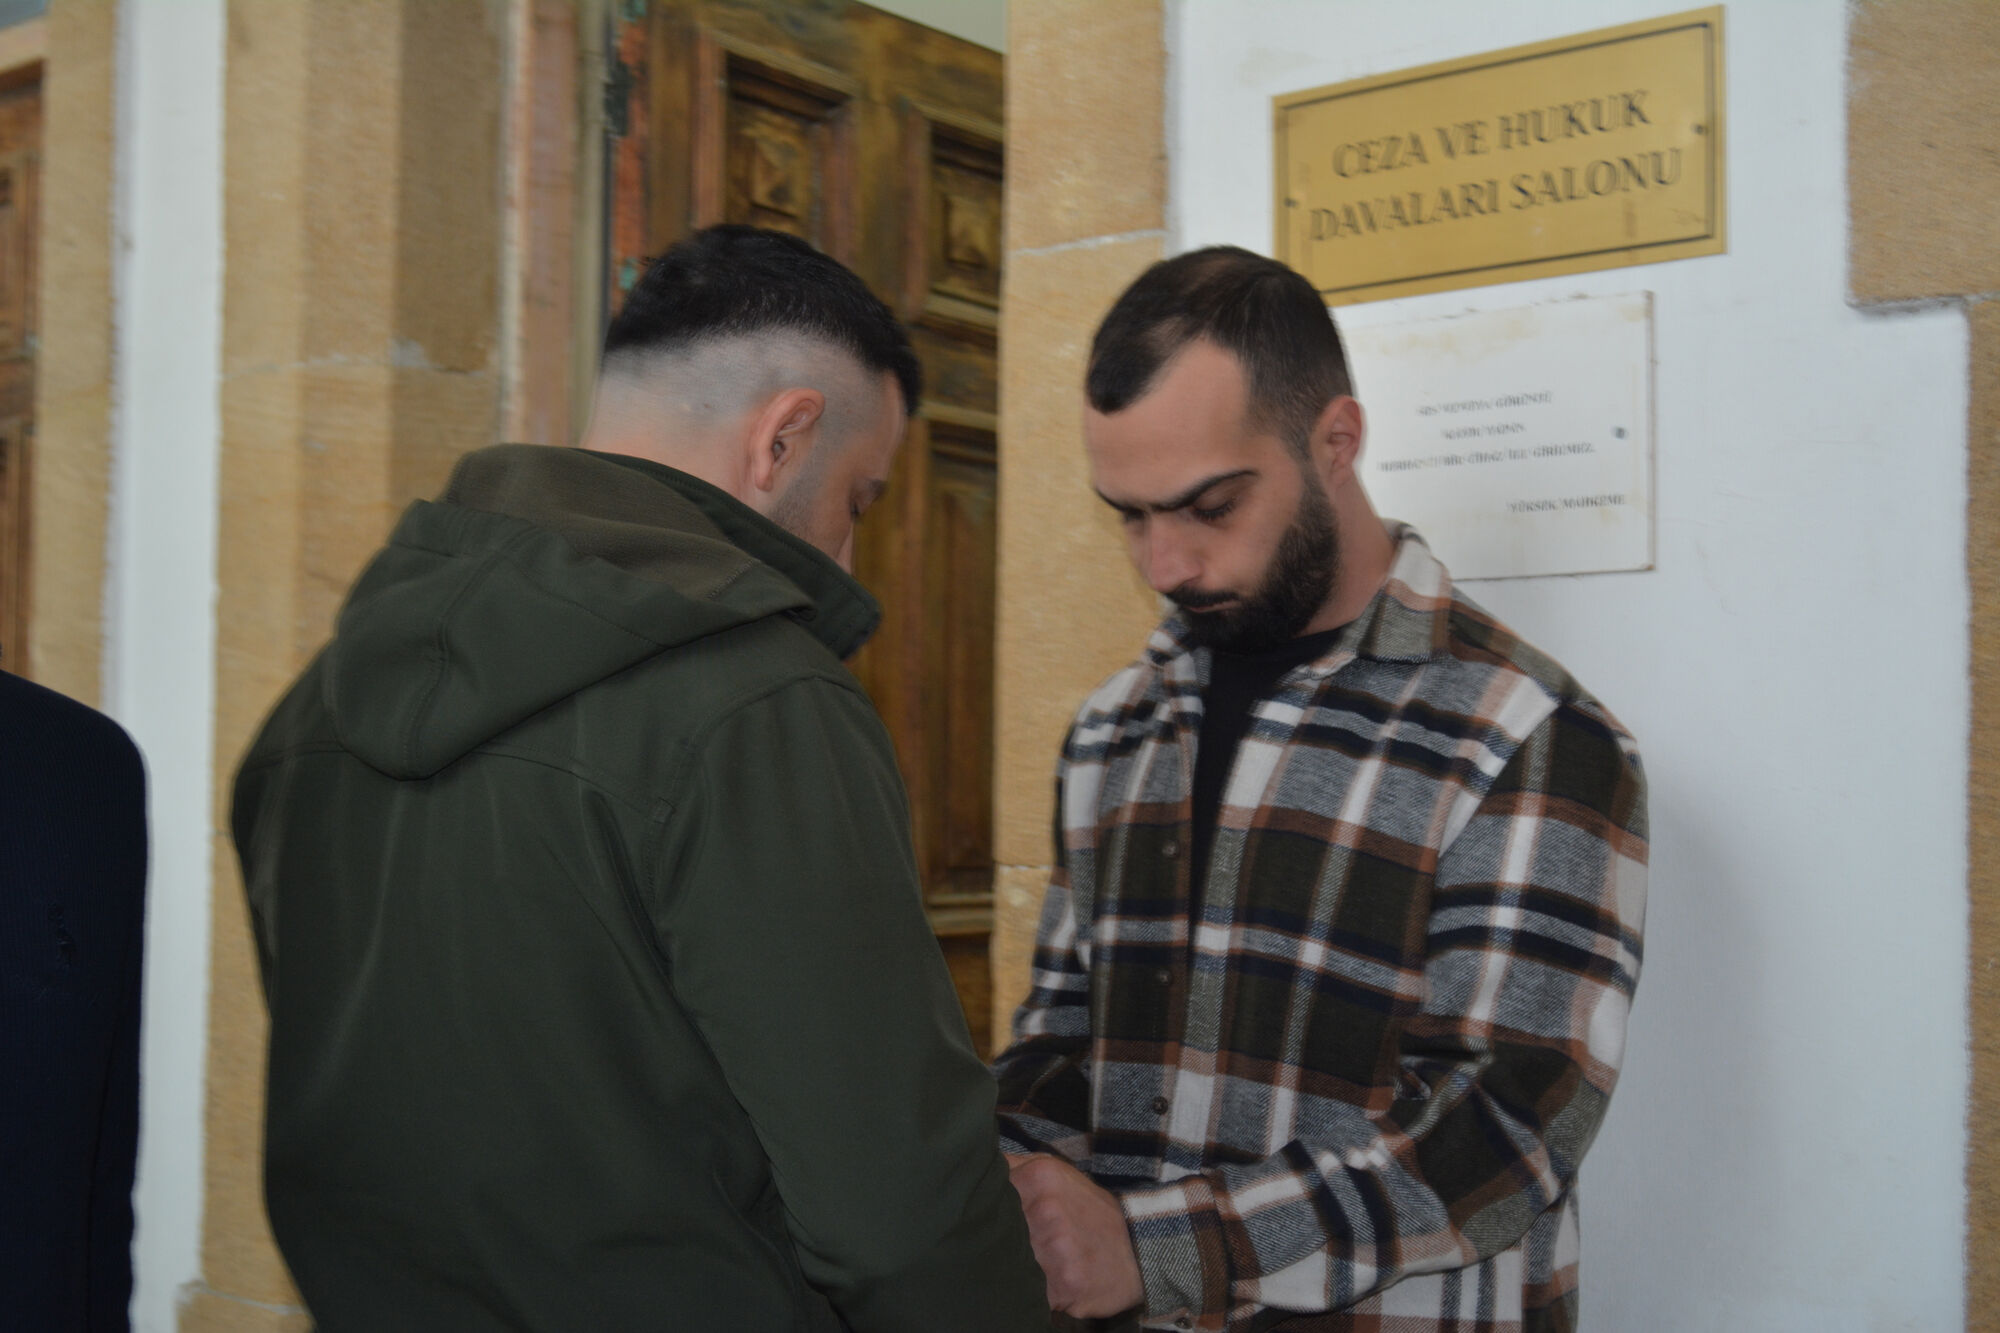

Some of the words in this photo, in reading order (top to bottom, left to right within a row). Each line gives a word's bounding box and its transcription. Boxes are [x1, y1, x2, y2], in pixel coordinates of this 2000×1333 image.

[1332, 133, 1428, 178] CEZA
[1435, 120, 1489, 159] VE
[1497, 89, 1651, 150] HUKUK
[1309, 179, 1499, 241] DAVALARI
[1509, 148, 1683, 210] SALONU
